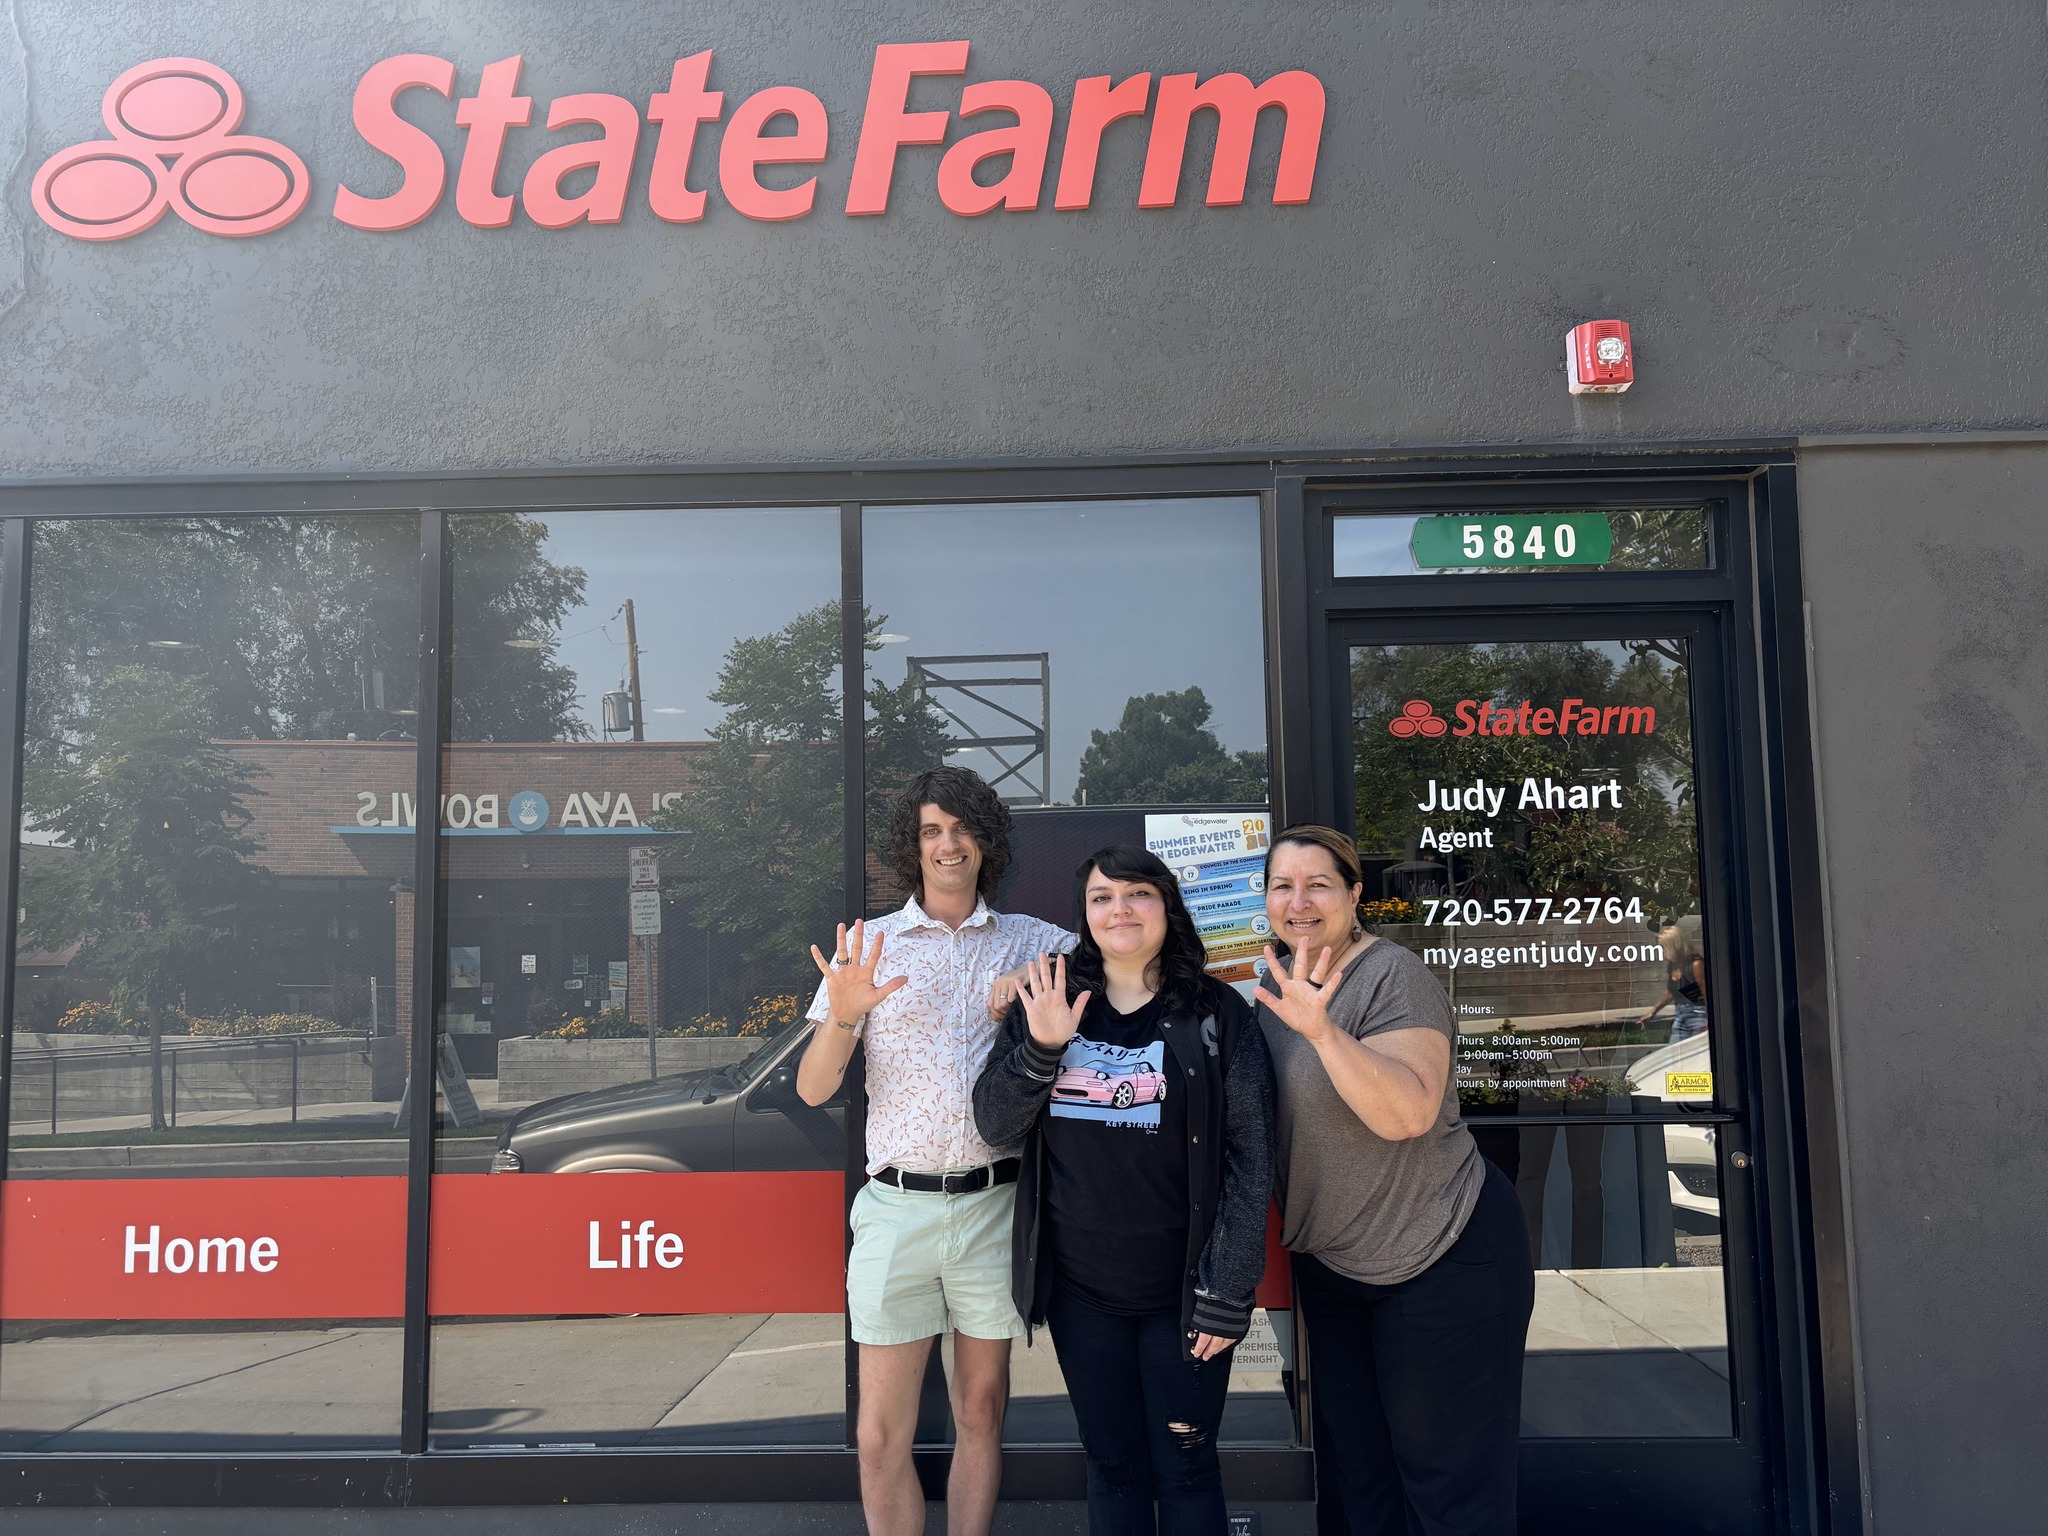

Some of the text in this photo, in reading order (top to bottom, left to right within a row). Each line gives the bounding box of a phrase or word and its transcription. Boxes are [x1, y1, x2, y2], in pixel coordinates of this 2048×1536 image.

[1463, 524, 1576, 560] 5840
[1418, 777, 1623, 818] Judy Ahart
[1194, 818, 1228, 826] edgewater
[1242, 819, 1265, 835] 20
[1149, 829, 1242, 850] SUMMER EVENTS
[1419, 826, 1494, 853] Agent
[1167, 841, 1236, 859] EDGEWATER
[1200, 862, 1223, 870] COUNCIL
[1240, 855, 1266, 864] COMMUNIT
[1210, 883, 1233, 891] SPRING
[1217, 900, 1242, 908] PARADE
[1422, 896, 1644, 926] 720-577-2764
[1423, 940, 1664, 970] myagentjudy.com
[1460, 1004, 1495, 1014] Hours:
[1456, 1078, 1566, 1090] hours by appointment
[1680, 1077, 1709, 1085] ARMOR
[1126, 1121, 1160, 1129] STREET
[124, 1225, 279, 1274] Home
[589, 1220, 684, 1269] Life
[1251, 1318, 1271, 1327] ASH
[1232, 1355, 1278, 1364] VERNIGHT
